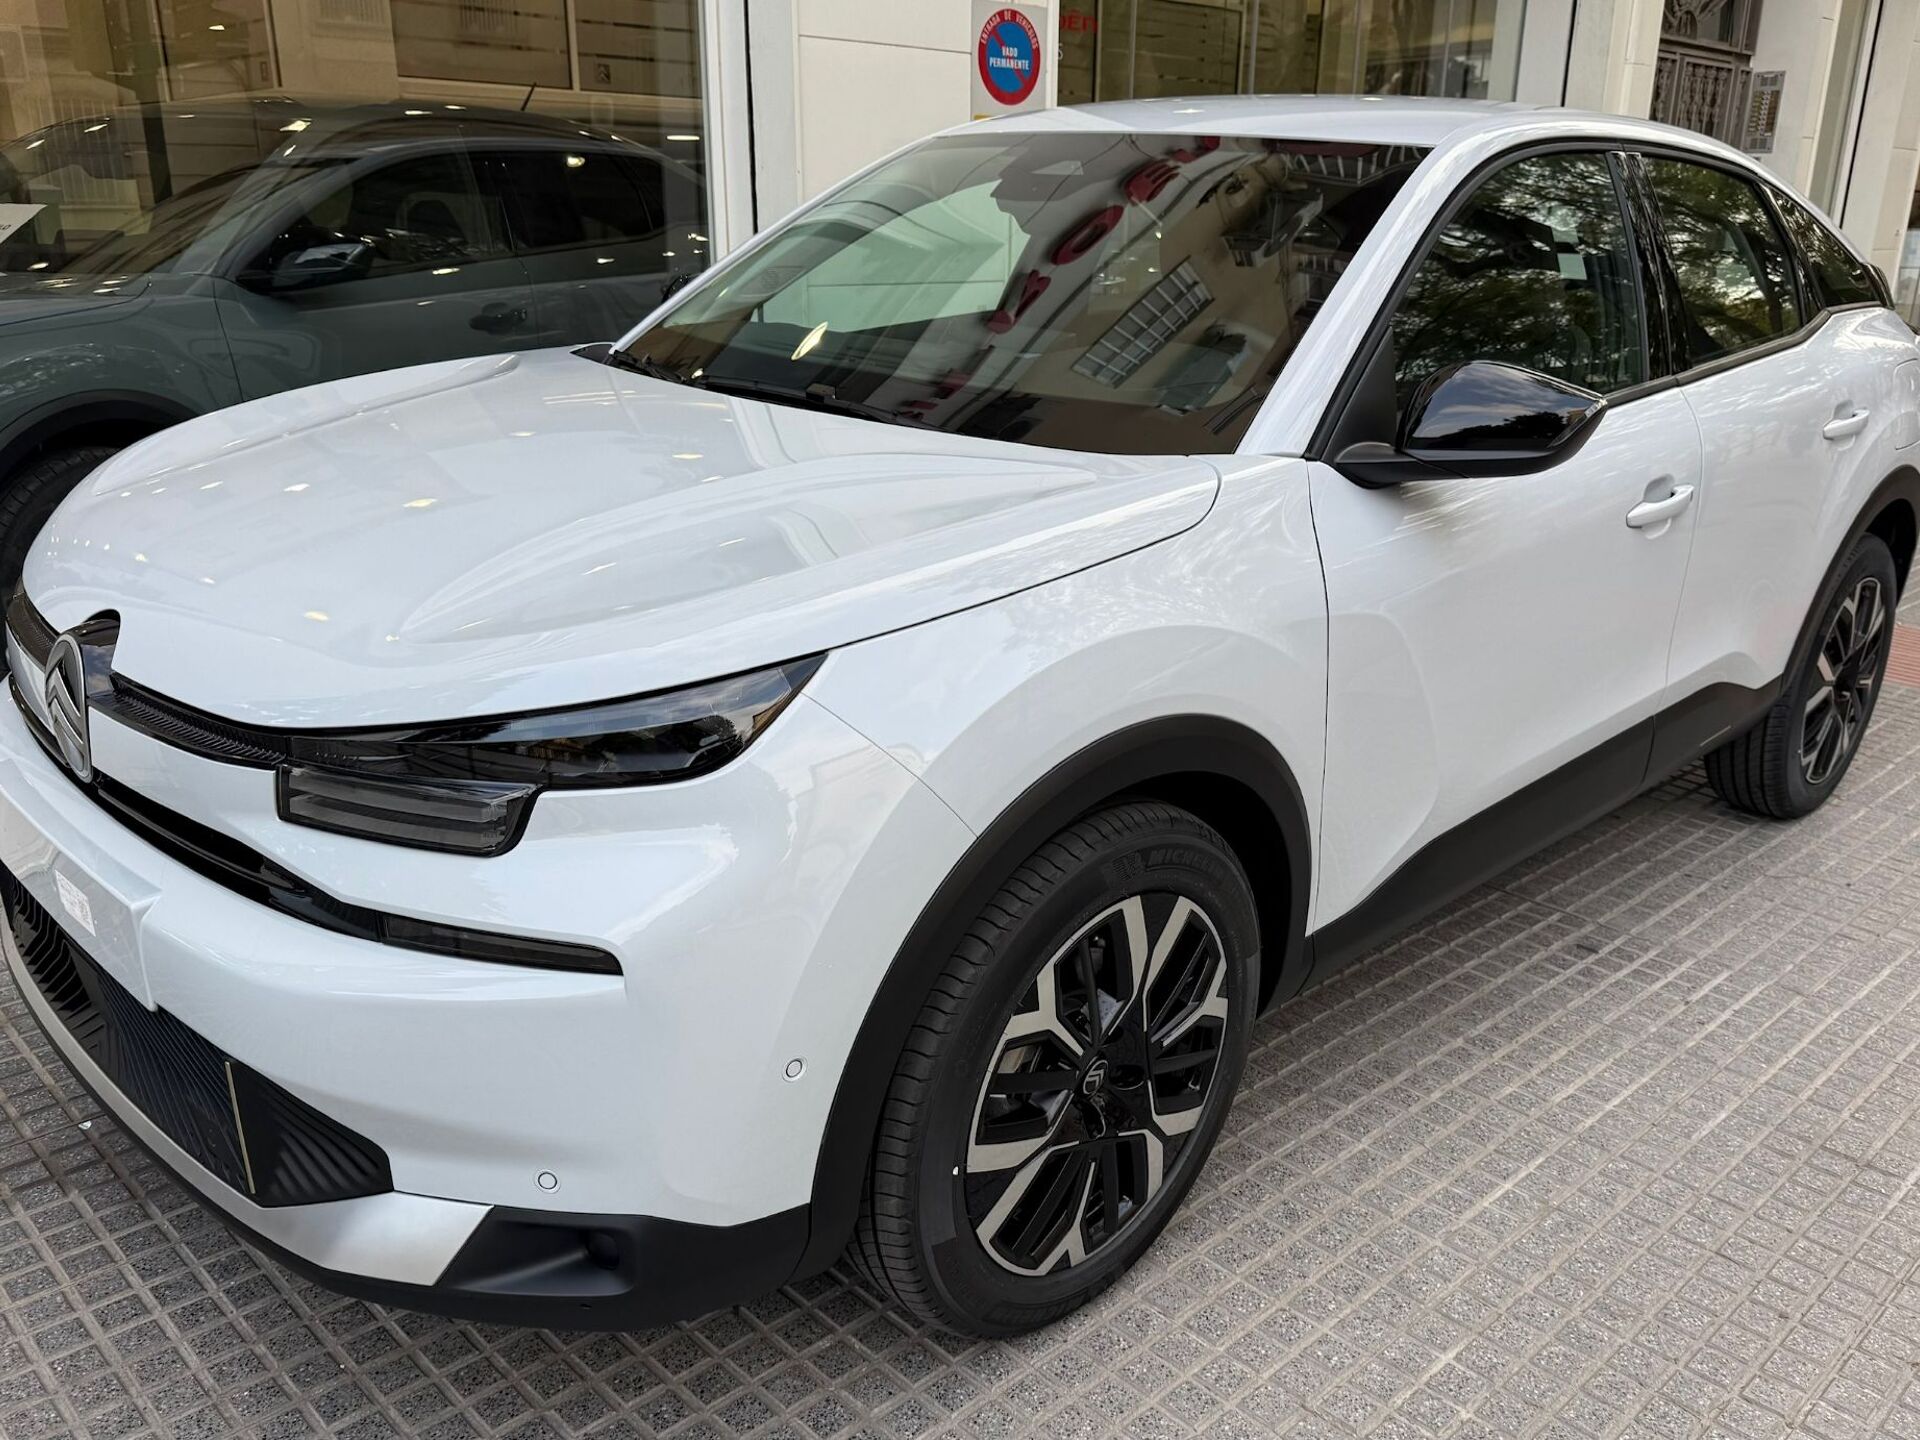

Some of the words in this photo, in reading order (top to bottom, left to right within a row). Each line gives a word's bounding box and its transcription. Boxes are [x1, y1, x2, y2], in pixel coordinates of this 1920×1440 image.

[1003, 9, 1012, 21] DE
[1001, 46, 1018, 57] VADO
[989, 56, 1029, 70] PERMANENTE
